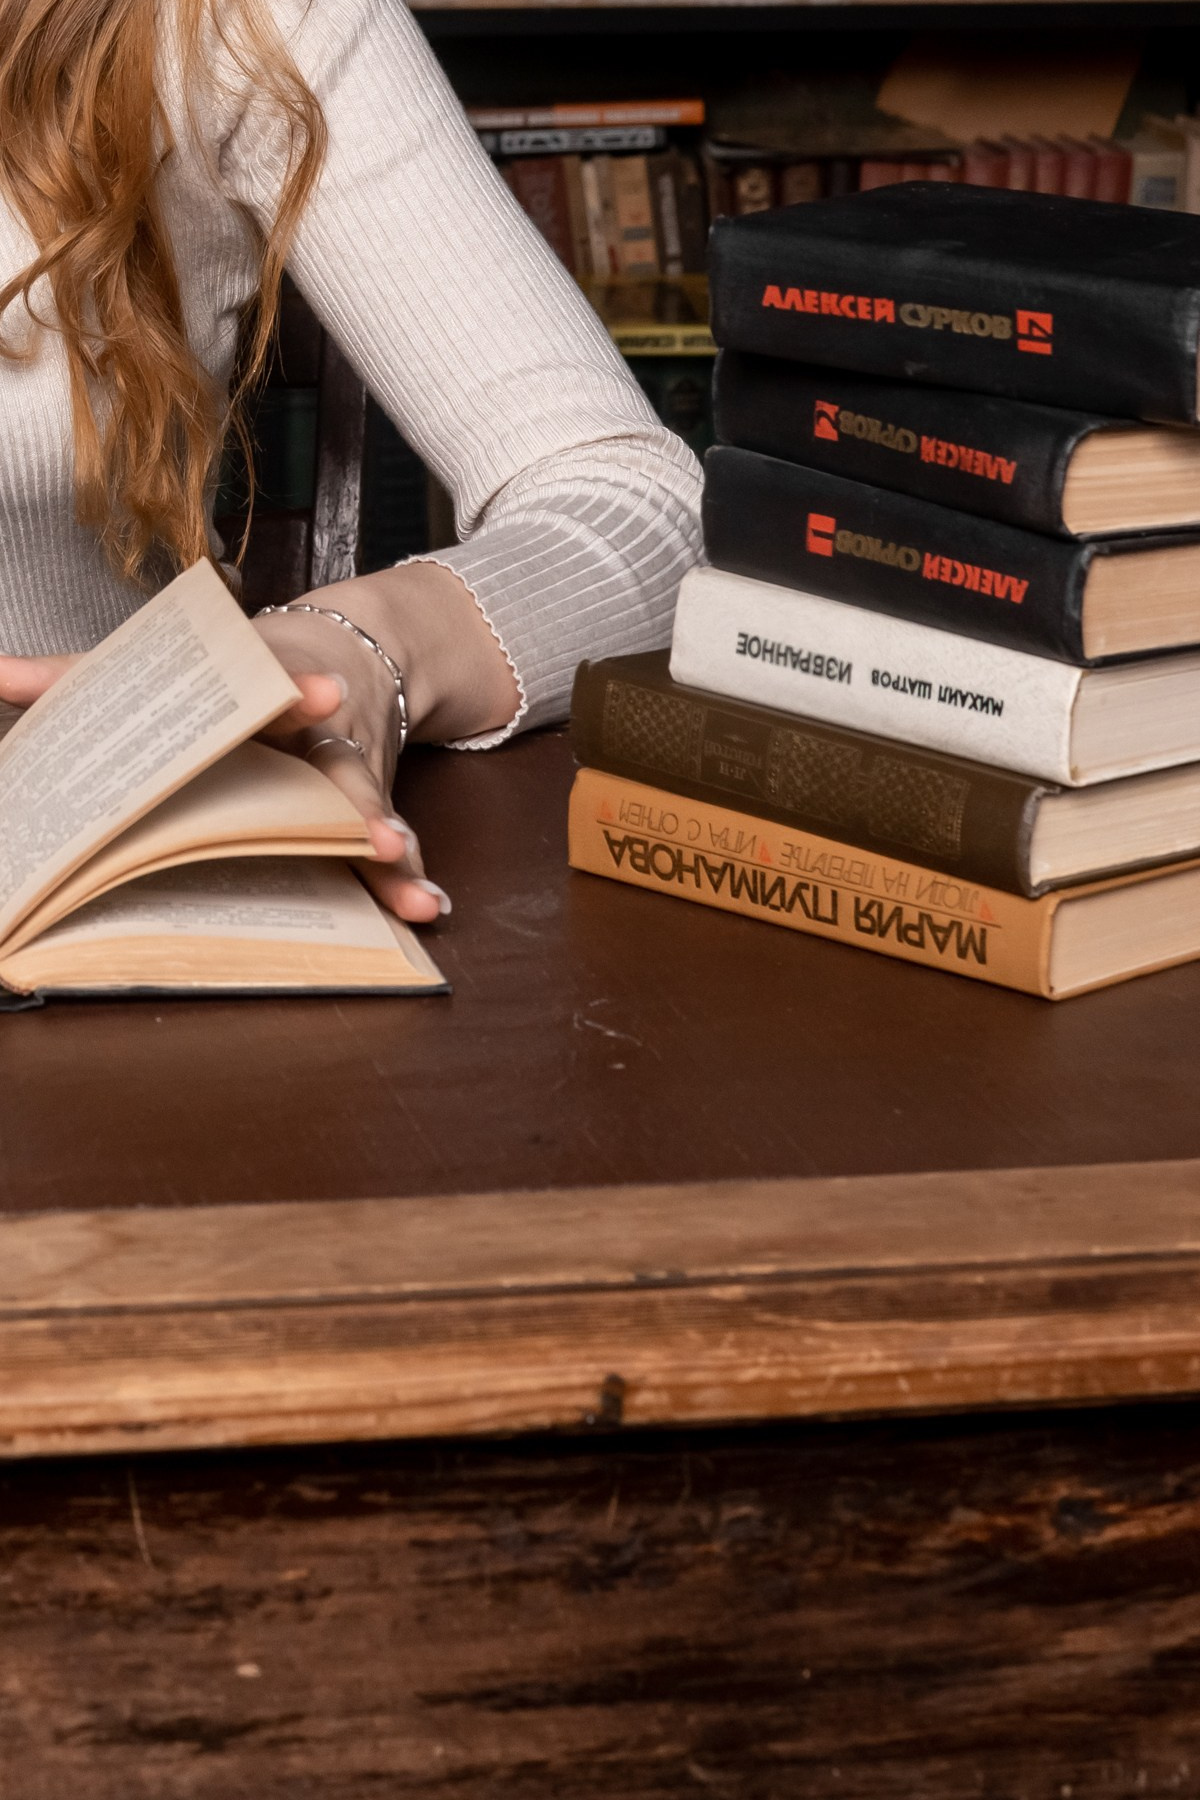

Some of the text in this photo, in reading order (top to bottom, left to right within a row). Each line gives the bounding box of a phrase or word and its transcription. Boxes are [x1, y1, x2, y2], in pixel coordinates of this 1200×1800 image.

[761, 284, 896, 324] АЛЕКСЕЙ
[899, 302, 1012, 340] СУРКОВ
[838, 409, 918, 454] СУРКОВ
[920, 434, 1017, 485] АЛЕКСЕЙ
[834, 529, 921, 572] СУРКОВ
[921, 551, 1030, 605] АЛЕКСЕЙ
[735, 631, 1004, 718] МИХАИЛ ШАТРОВ ИЗБРАННОЕ
[618, 798, 758, 858] ИГРА С ОГНЕМ
[602, 828, 987, 966] МАРИЯ ПУЙМАНОВА
[779, 841, 980, 914] ЛЮДИ НА ПЕРЕПУТЬЕ
